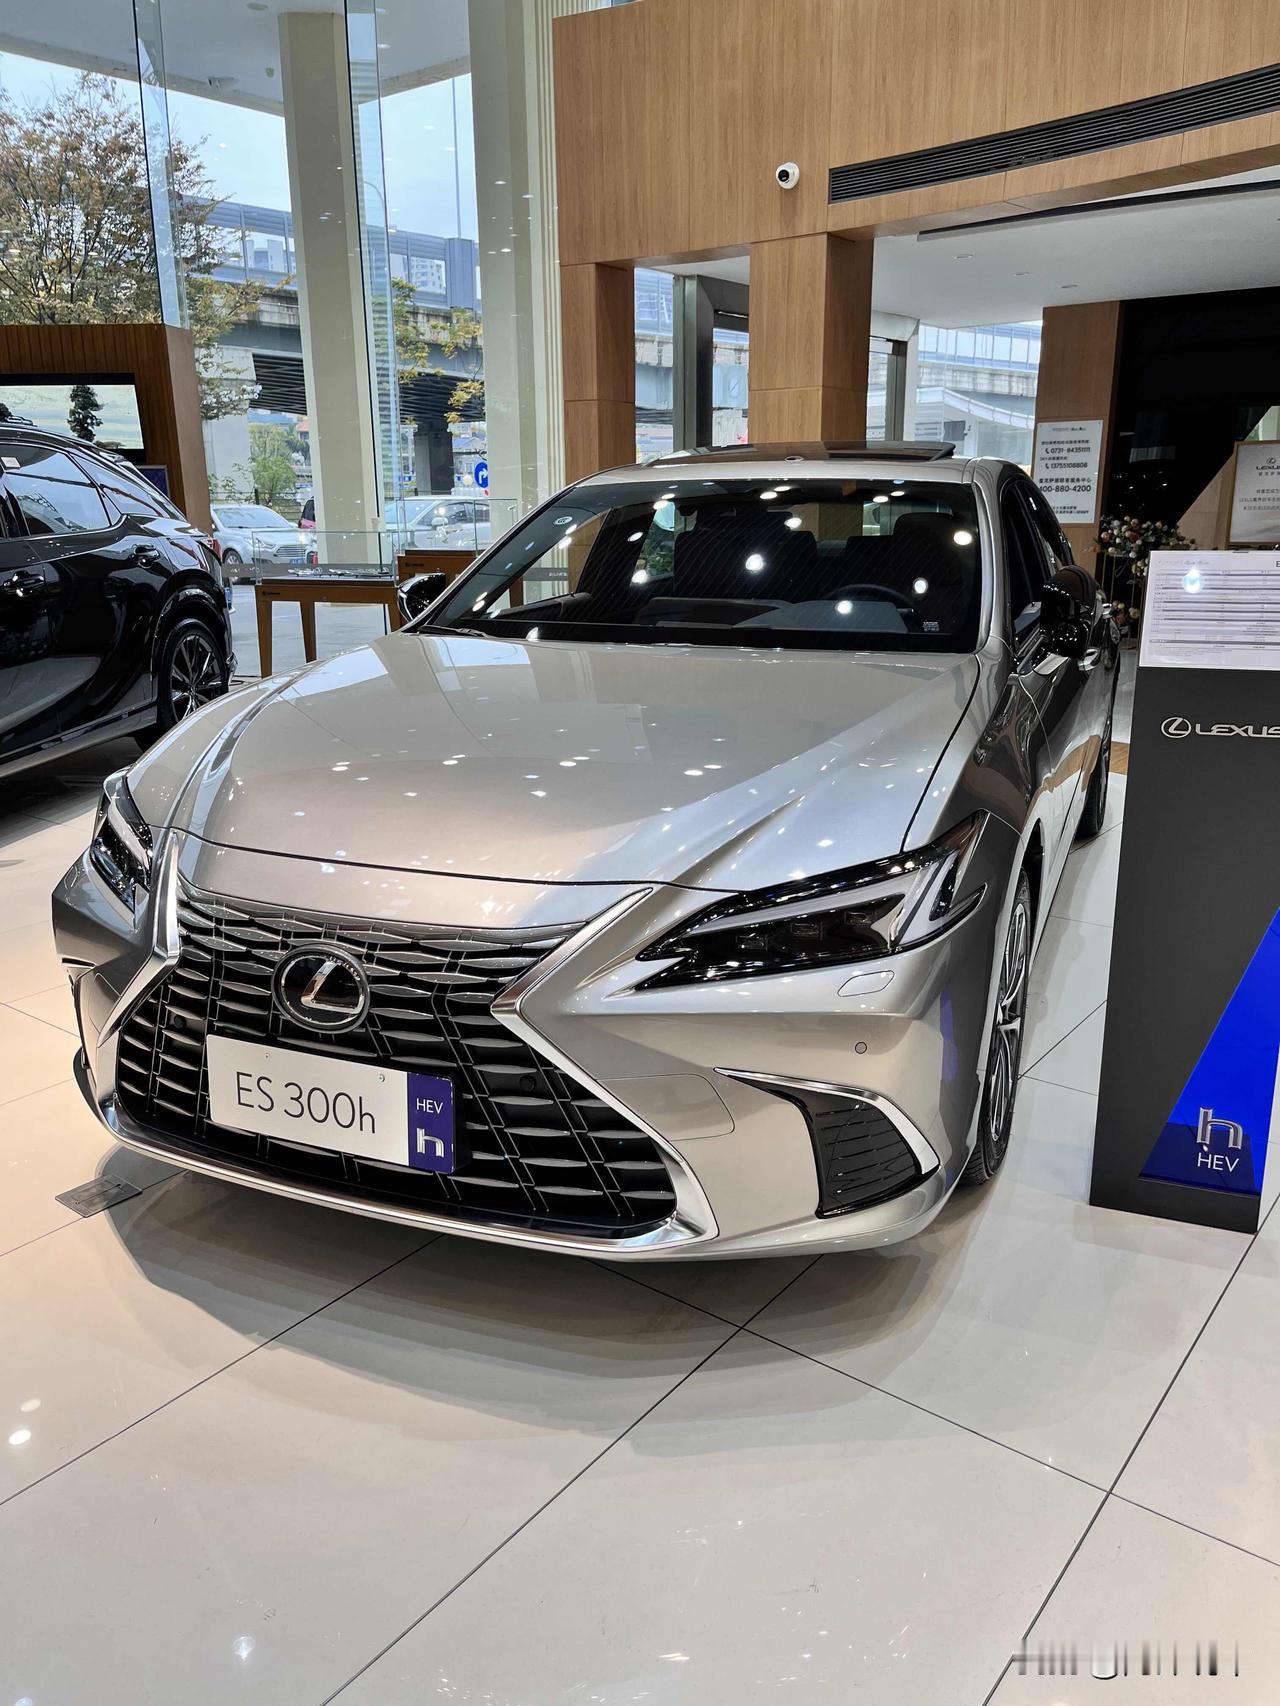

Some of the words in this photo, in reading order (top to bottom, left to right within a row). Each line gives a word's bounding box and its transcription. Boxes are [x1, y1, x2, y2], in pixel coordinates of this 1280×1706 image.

[236, 1071, 275, 1112] ES
[283, 1081, 377, 1134] 300h
[416, 1097, 444, 1114] HEV
[1197, 1152, 1240, 1173] HEV
